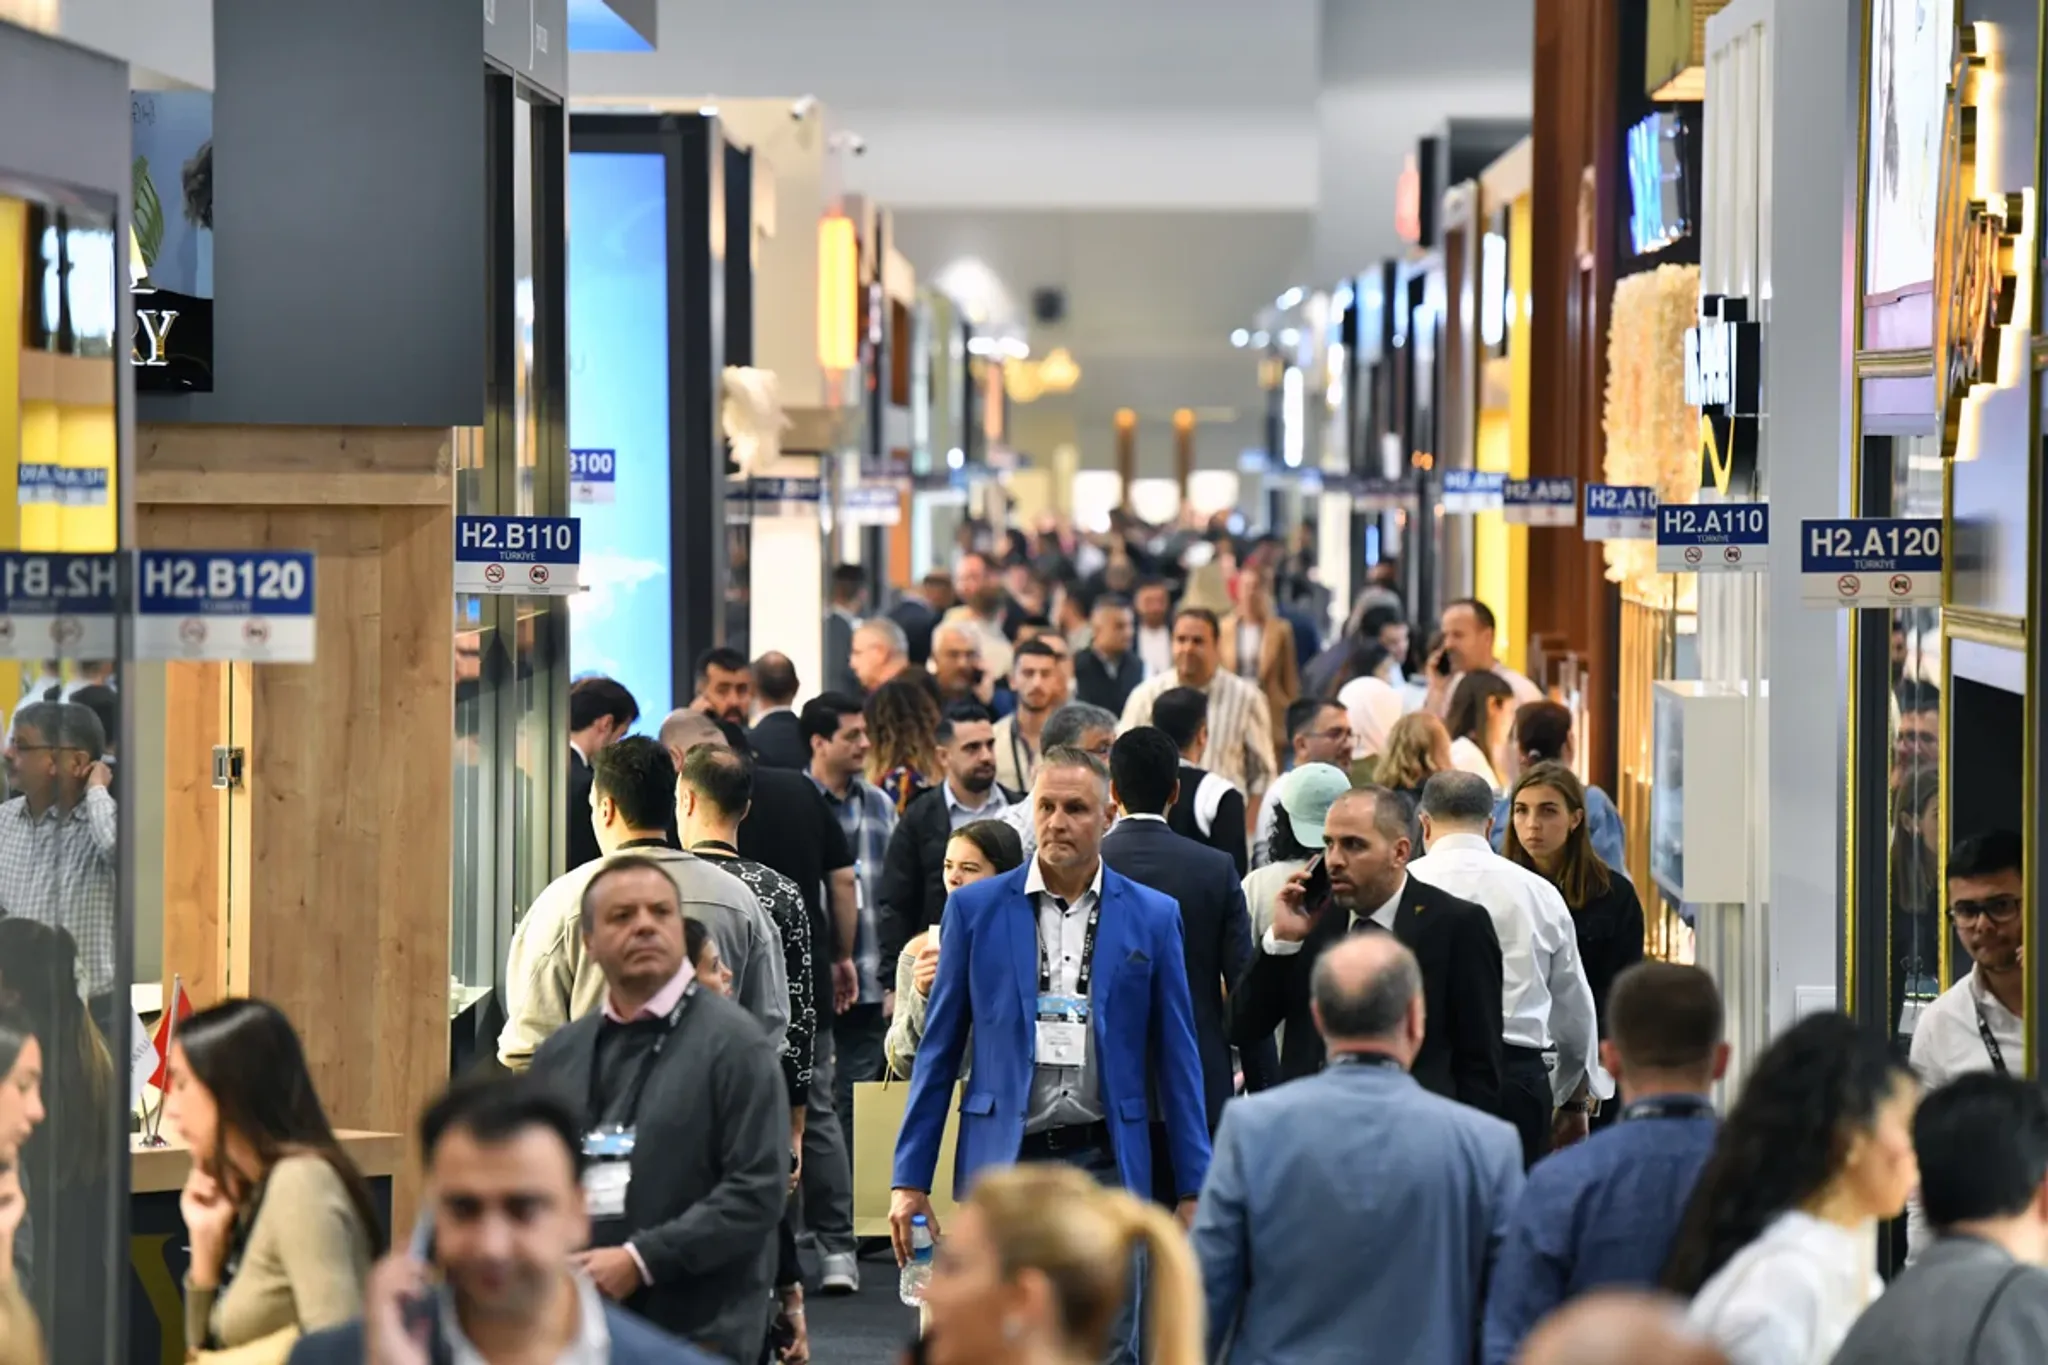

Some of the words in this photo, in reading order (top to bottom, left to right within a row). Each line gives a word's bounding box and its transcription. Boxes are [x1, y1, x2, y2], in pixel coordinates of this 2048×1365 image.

[462, 521, 571, 551] H2.B110
[1664, 509, 1763, 534] H2.A110
[1811, 527, 1940, 557] H2.A120
[144, 557, 305, 601] H2.B120
